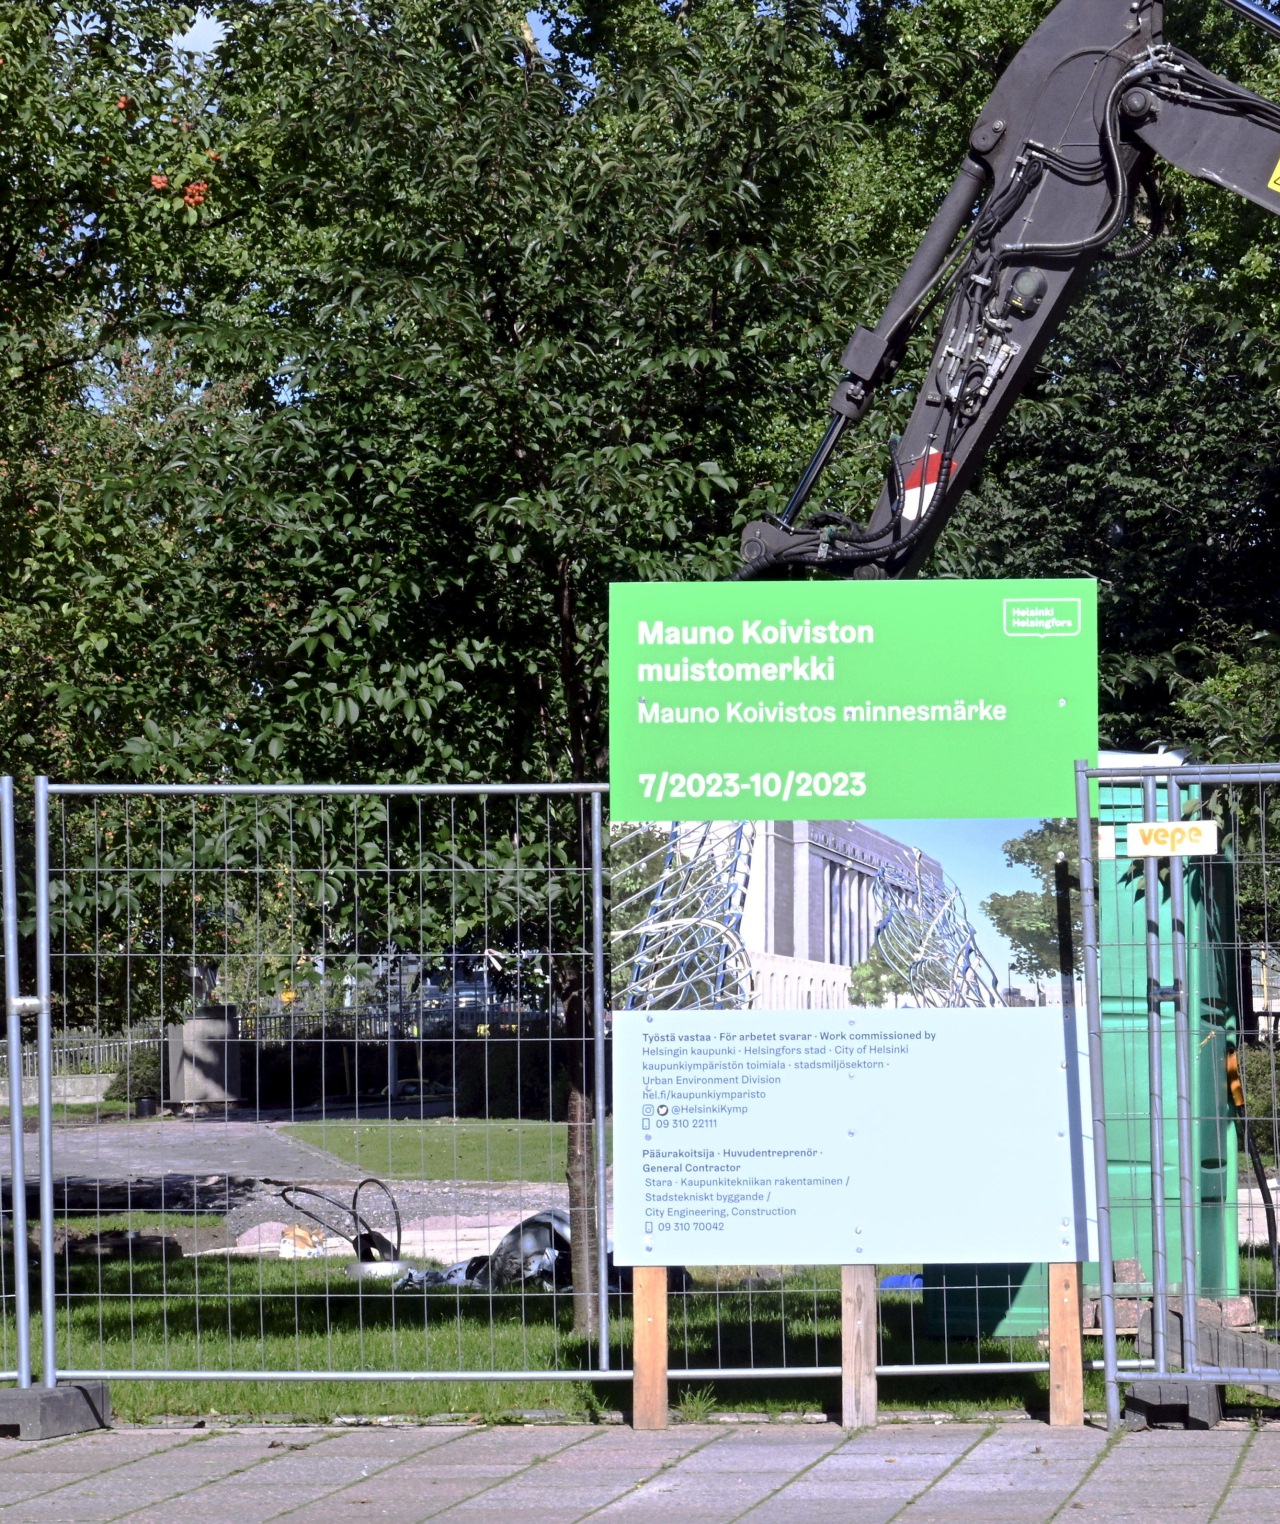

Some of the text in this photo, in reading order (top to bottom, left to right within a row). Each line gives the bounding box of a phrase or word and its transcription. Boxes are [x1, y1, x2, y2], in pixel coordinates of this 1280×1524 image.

[1012, 607, 1055, 616] Helsinki
[1012, 617, 1073, 630] Helsingfors
[637, 619, 874, 645] Mauno Koiviston
[637, 656, 836, 682] muistomerkki
[637, 699, 1008, 724] Mauno Koivistos minnesmärke
[638, 770, 868, 802] 7/2023-10/2023
[1138, 826, 1202, 852] vepe
[641, 1030, 937, 1045] Työstä vastaa För arbetet svarar Work commissioned by
[642, 1044, 909, 1058] Helsingin kaupunki Helsingfors stad City of Helsinki
[642, 1059, 884, 1073] kaupunkiympäristön toimiala stadsmiljösektorn
[642, 1074, 781, 1086] Urban Environment Division
[642, 1090, 767, 1101] hel.fi/kaupunkiymparisto
[671, 1104, 749, 1116] @HelsinkiKymp
[655, 1118, 717, 1129] 09 310 22111
[642, 1147, 818, 1160] Pääurakoitsija Huvudentreprenör
[642, 1163, 742, 1173] General Contractor
[645, 1177, 673, 1187] Stara
[680, 1176, 772, 1189] Kaupunkitekniikan
[774, 1176, 843, 1186] rakentaminen
[645, 1192, 714, 1202] Stadstekniskt
[716, 1191, 764, 1204] byggande
[644, 1206, 797, 1219] City Engineering, Construction
[657, 1221, 725, 1232] 09 310 70042
